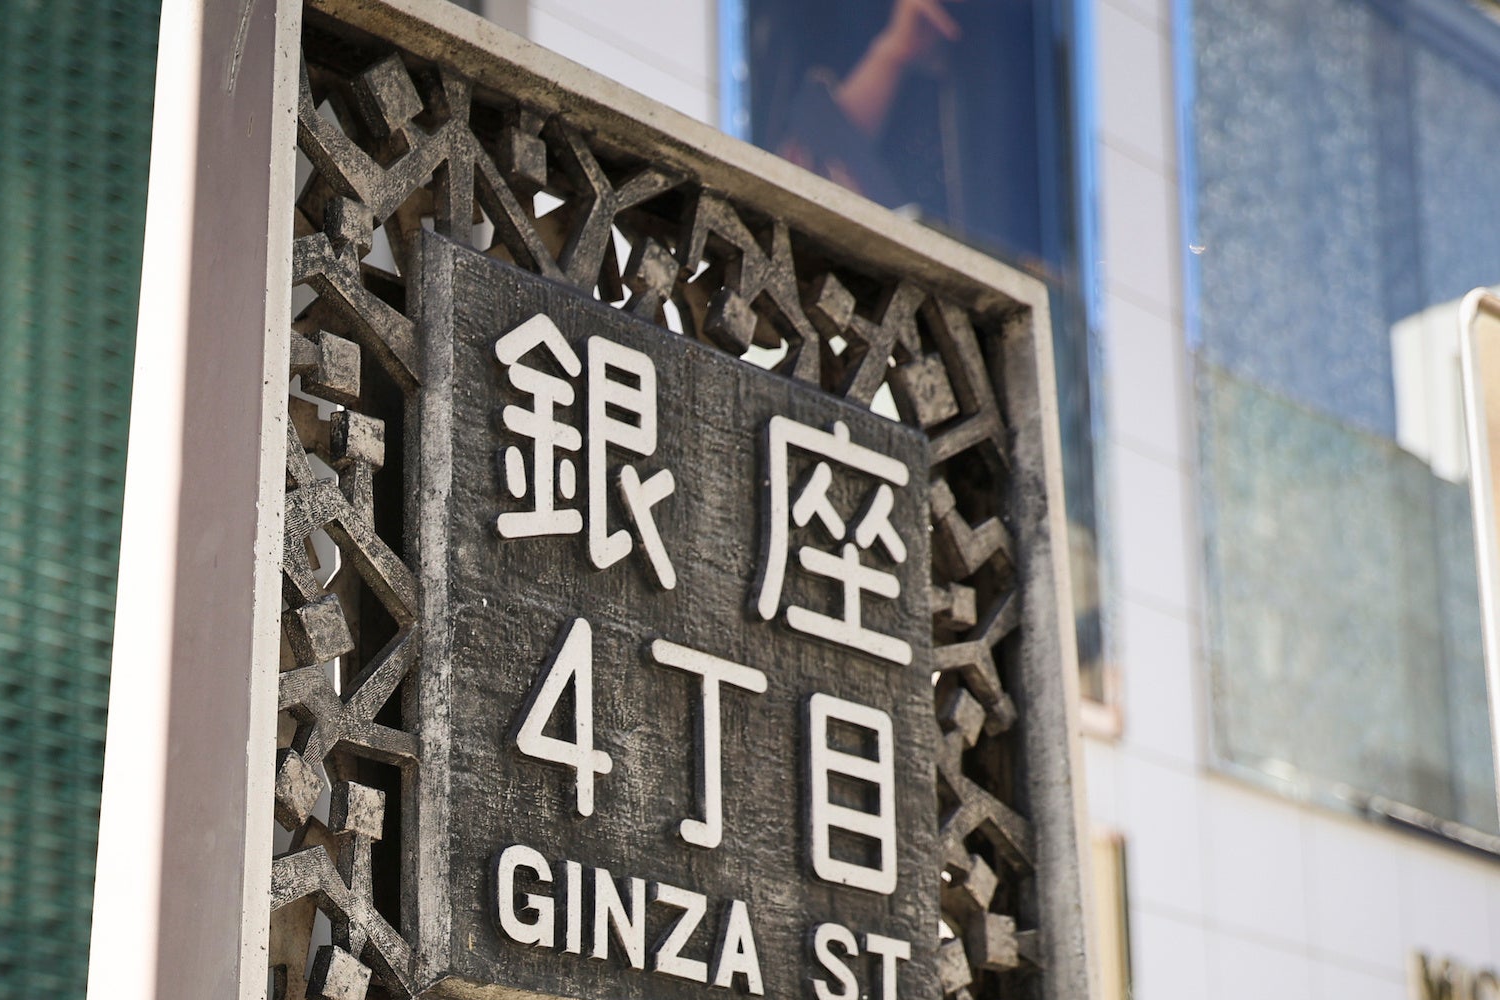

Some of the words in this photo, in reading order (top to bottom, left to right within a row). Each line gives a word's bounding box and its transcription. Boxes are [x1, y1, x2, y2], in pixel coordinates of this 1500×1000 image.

[495, 312, 912, 666] 銀座
[514, 616, 899, 896] 4丁目
[497, 843, 765, 997] GINZA
